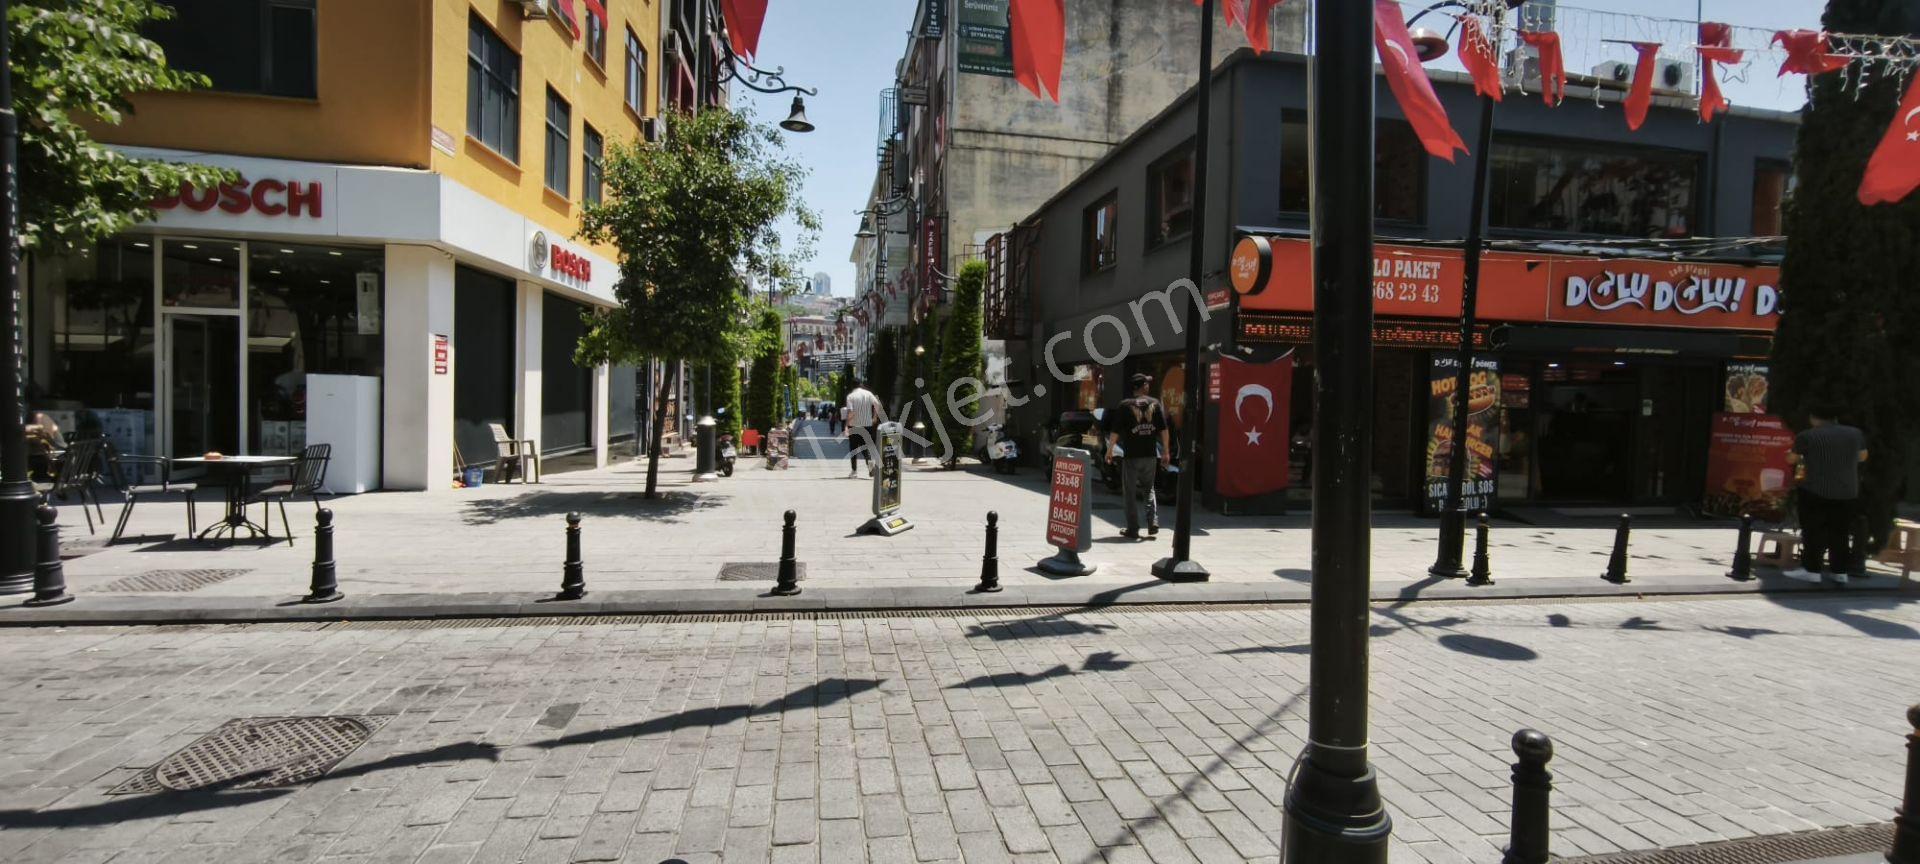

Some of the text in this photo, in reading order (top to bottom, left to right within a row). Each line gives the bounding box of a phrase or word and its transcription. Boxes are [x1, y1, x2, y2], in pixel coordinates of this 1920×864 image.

[150, 178, 322, 218] OSCH
[551, 245, 591, 281] BOSCH
[1373, 259, 1441, 279] LO PAKET
[1399, 283, 1417, 301] 23
[1422, 284, 1439, 303] 43
[1567, 270, 1649, 310] DOLU
[1653, 275, 1746, 314] DOLU!
[1431, 371, 1487, 396] HOT OG
[1068, 462, 1083, 473] COPY
[1056, 473, 1080, 488] 33x48
[1428, 482, 1448, 498] SICA
[1478, 480, 1494, 494] SOS
[1054, 490, 1078, 506] A1-A3
[1053, 507, 1076, 523] BASKI
